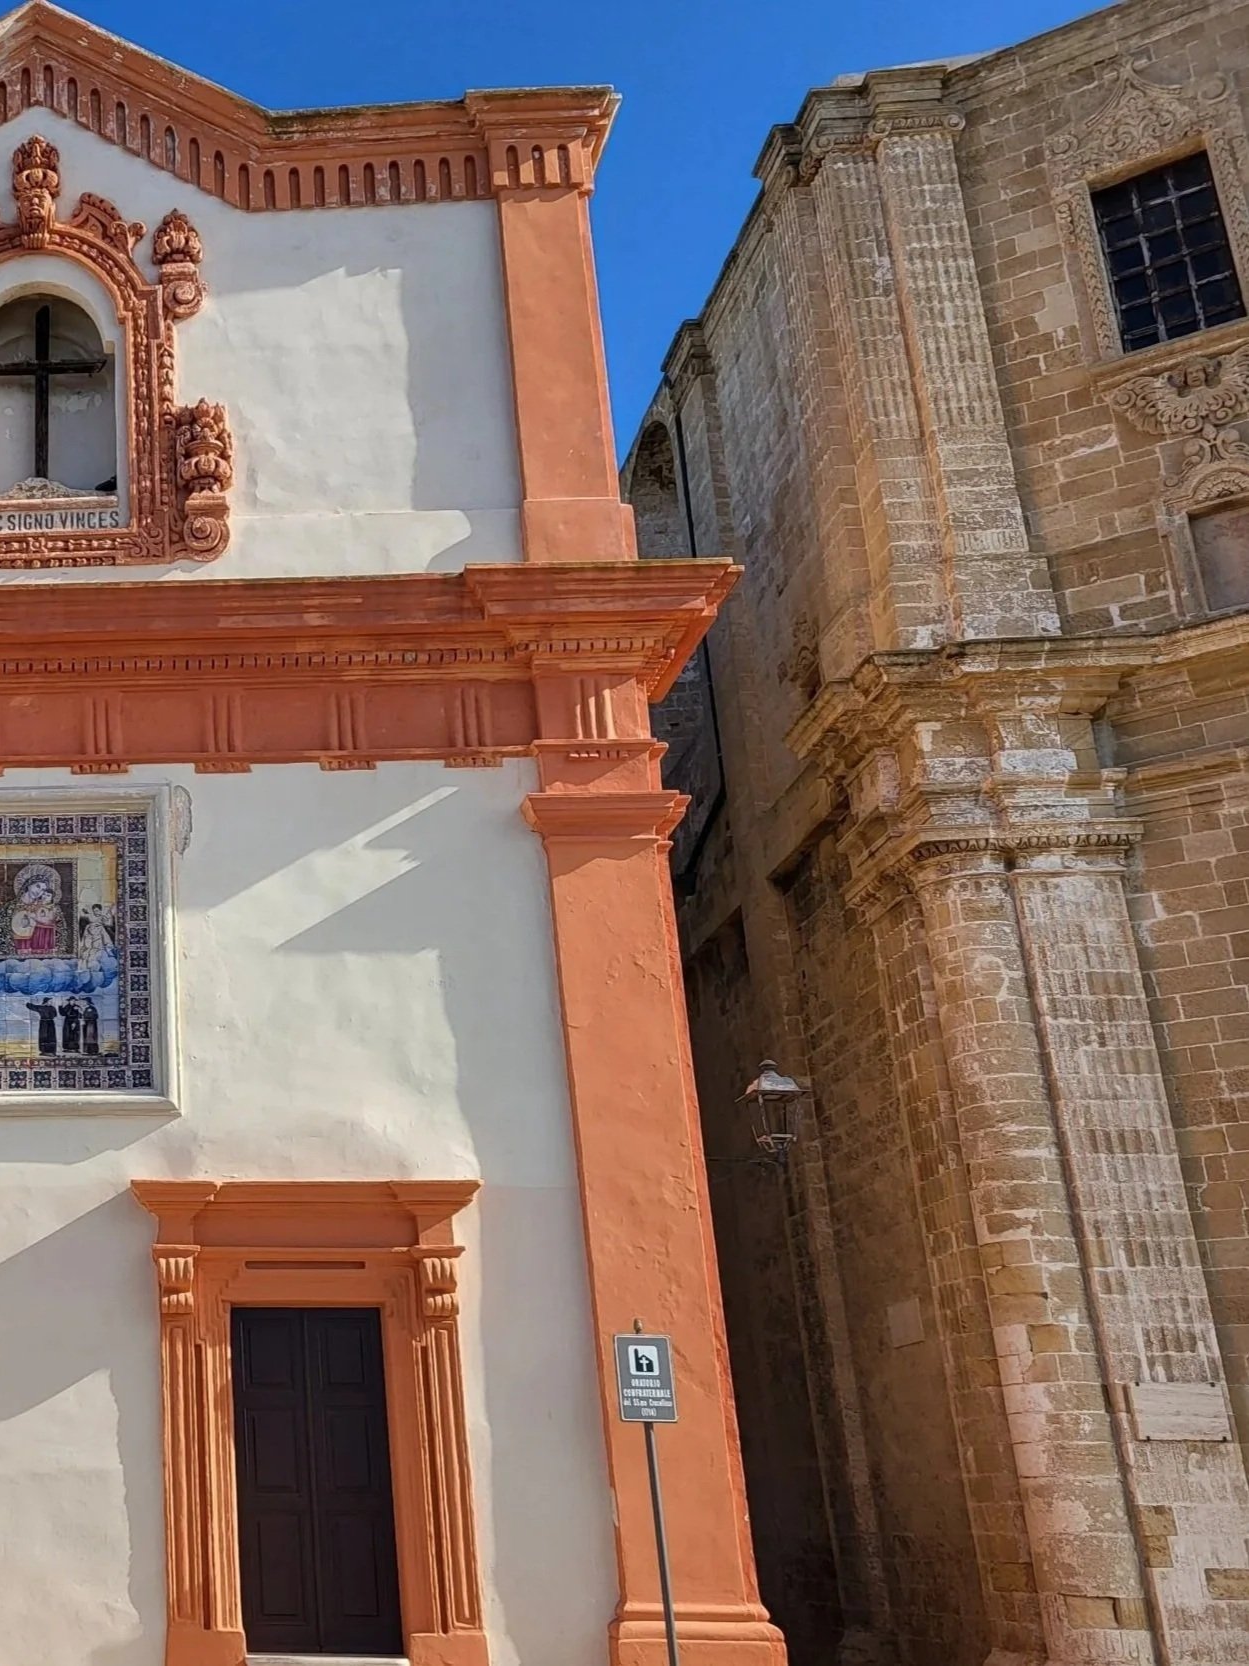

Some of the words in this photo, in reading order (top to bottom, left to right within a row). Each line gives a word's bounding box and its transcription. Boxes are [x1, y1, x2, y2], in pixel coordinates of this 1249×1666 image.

[7, 513, 54, 531] SIGNO
[59, 510, 119, 530] VINCES
[631, 1378, 660, 1388] ORATORIO
[623, 1389, 671, 1398] CONFRATERNALE
